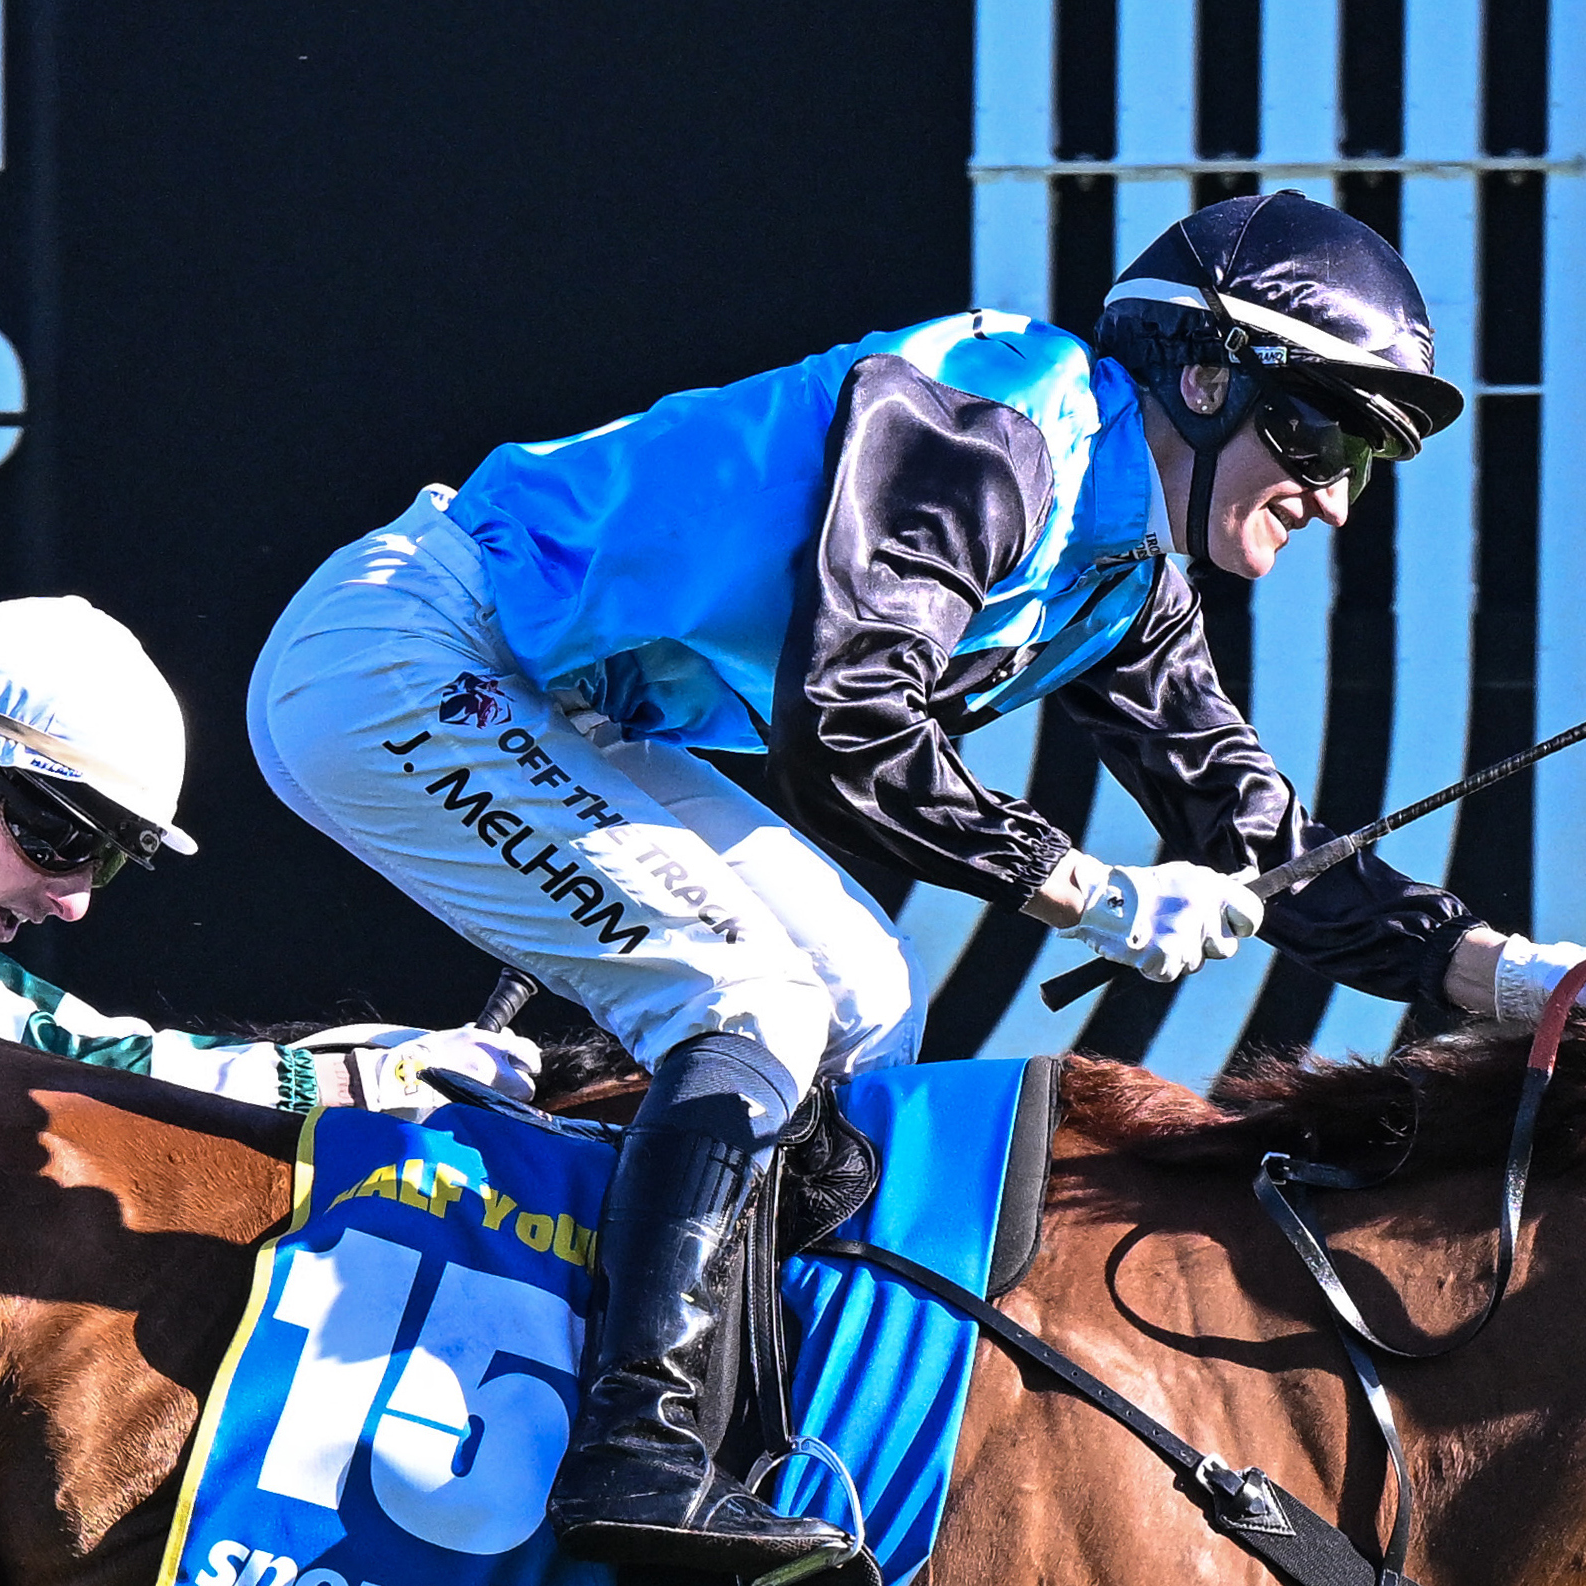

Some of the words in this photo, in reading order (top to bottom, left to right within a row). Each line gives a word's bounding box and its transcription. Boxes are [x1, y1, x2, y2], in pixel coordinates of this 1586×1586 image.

[382, 730, 432, 773] J.
[424, 767, 651, 955] MELHAM
[498, 728, 571, 788] OFF
[562, 786, 641, 845] THE
[636, 843, 745, 944] TRACK
[480, 1184, 598, 1276] YOU
[257, 1227, 586, 1556] 15
